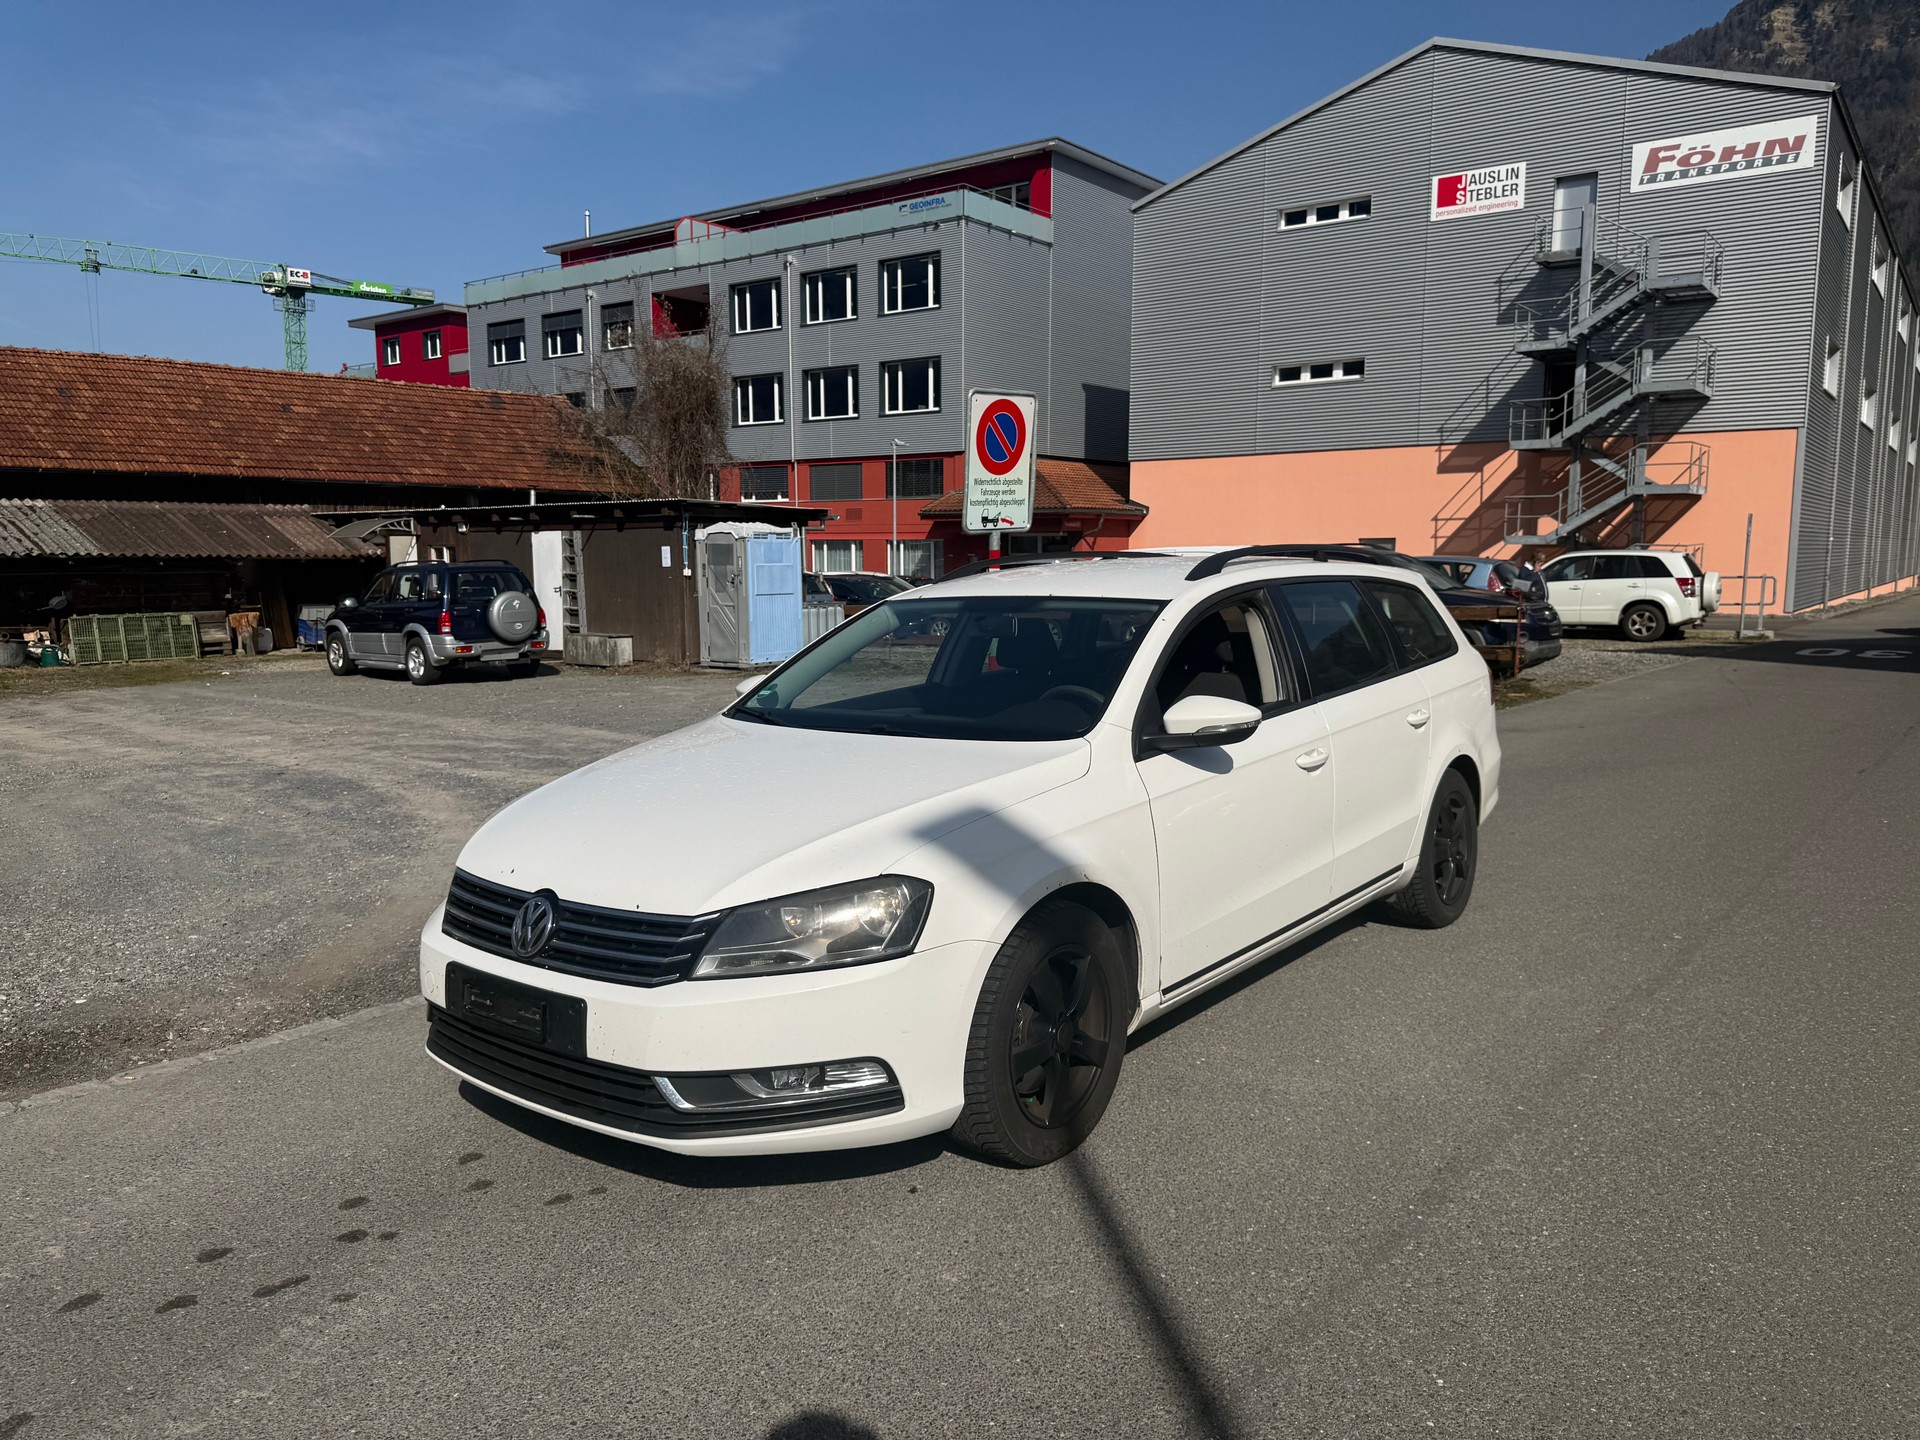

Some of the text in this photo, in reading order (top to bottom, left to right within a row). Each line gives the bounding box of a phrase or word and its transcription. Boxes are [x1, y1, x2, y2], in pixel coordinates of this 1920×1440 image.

[1642, 134, 1807, 174] FÖHN
[1641, 152, 1797, 184] TRANSPORTE
[1457, 166, 1520, 189] JAUSLIN
[1456, 183, 1519, 205] STEBLER
[909, 197, 946, 210] GEOINFRA
[1435, 200, 1518, 218] personalized engineering
[290, 270, 309, 279] EC-B
[974, 478, 1024, 487] Widerrechtlich abgestellte
[980, 488, 1016, 498] Fahrzeuge werden
[969, 498, 999, 508] kostenpflichtig
